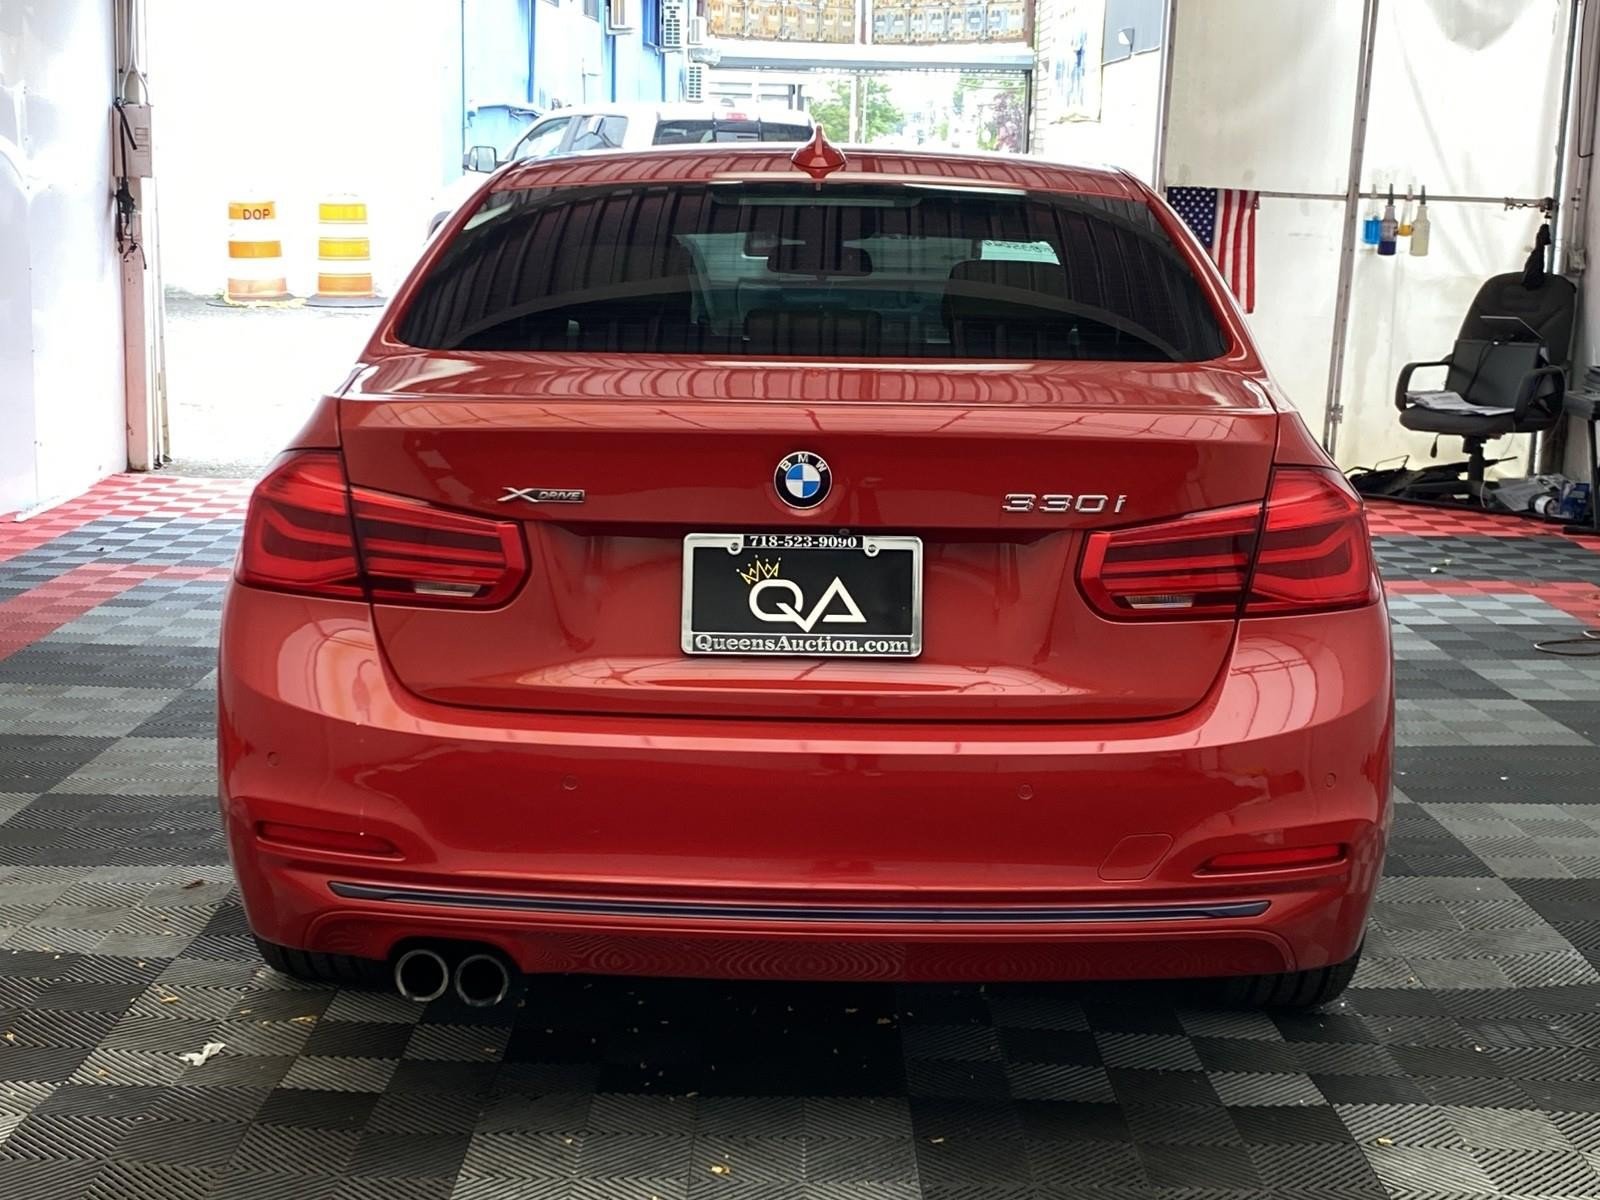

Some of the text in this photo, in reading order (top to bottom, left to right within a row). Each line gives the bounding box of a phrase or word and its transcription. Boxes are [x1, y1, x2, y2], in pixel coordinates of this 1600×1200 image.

[243, 208, 271, 221] DOP
[780, 453, 827, 473] BMW
[1002, 494, 1127, 513] 330i
[750, 535, 857, 549] 718-523-9090
[749, 576, 867, 633] QA
[695, 635, 910, 654] QueensAuction.com
